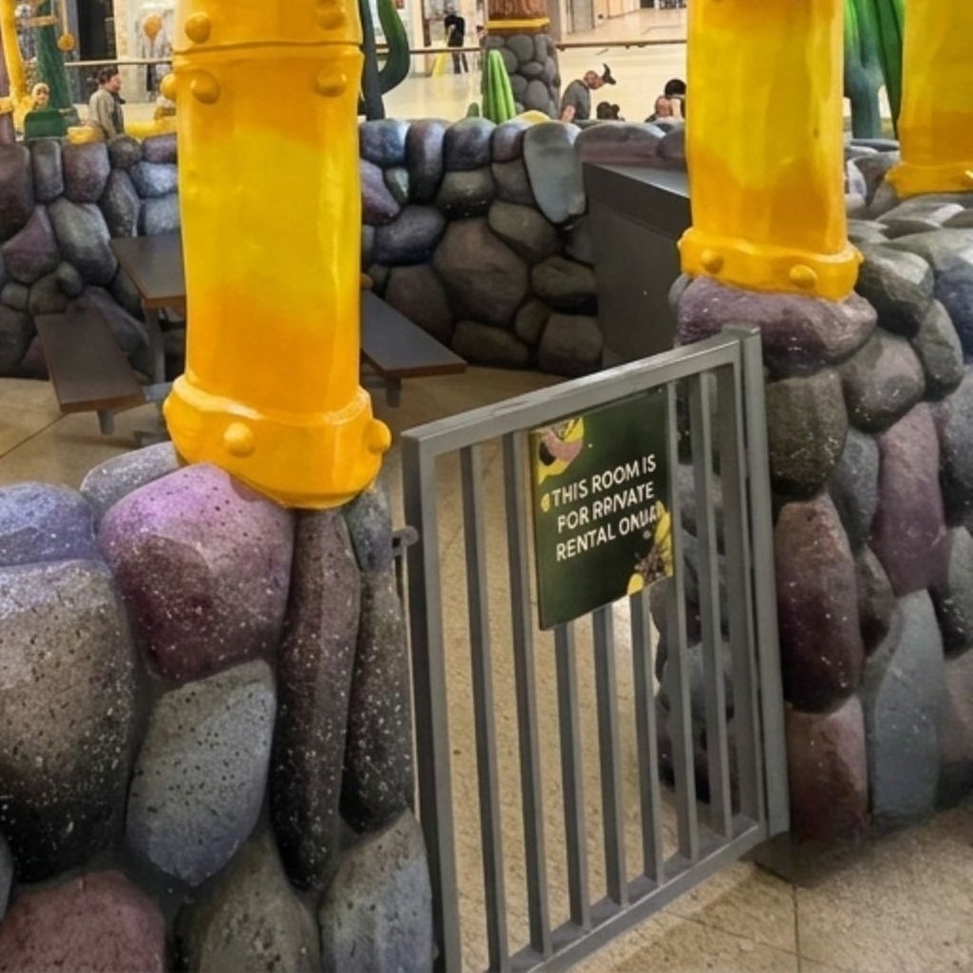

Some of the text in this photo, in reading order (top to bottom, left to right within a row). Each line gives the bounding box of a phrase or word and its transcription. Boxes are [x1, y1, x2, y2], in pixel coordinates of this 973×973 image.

[551, 453, 657, 507] THIS ROOM IS
[557, 506, 589, 533] FOR
[555, 523, 617, 562] RENTAL
